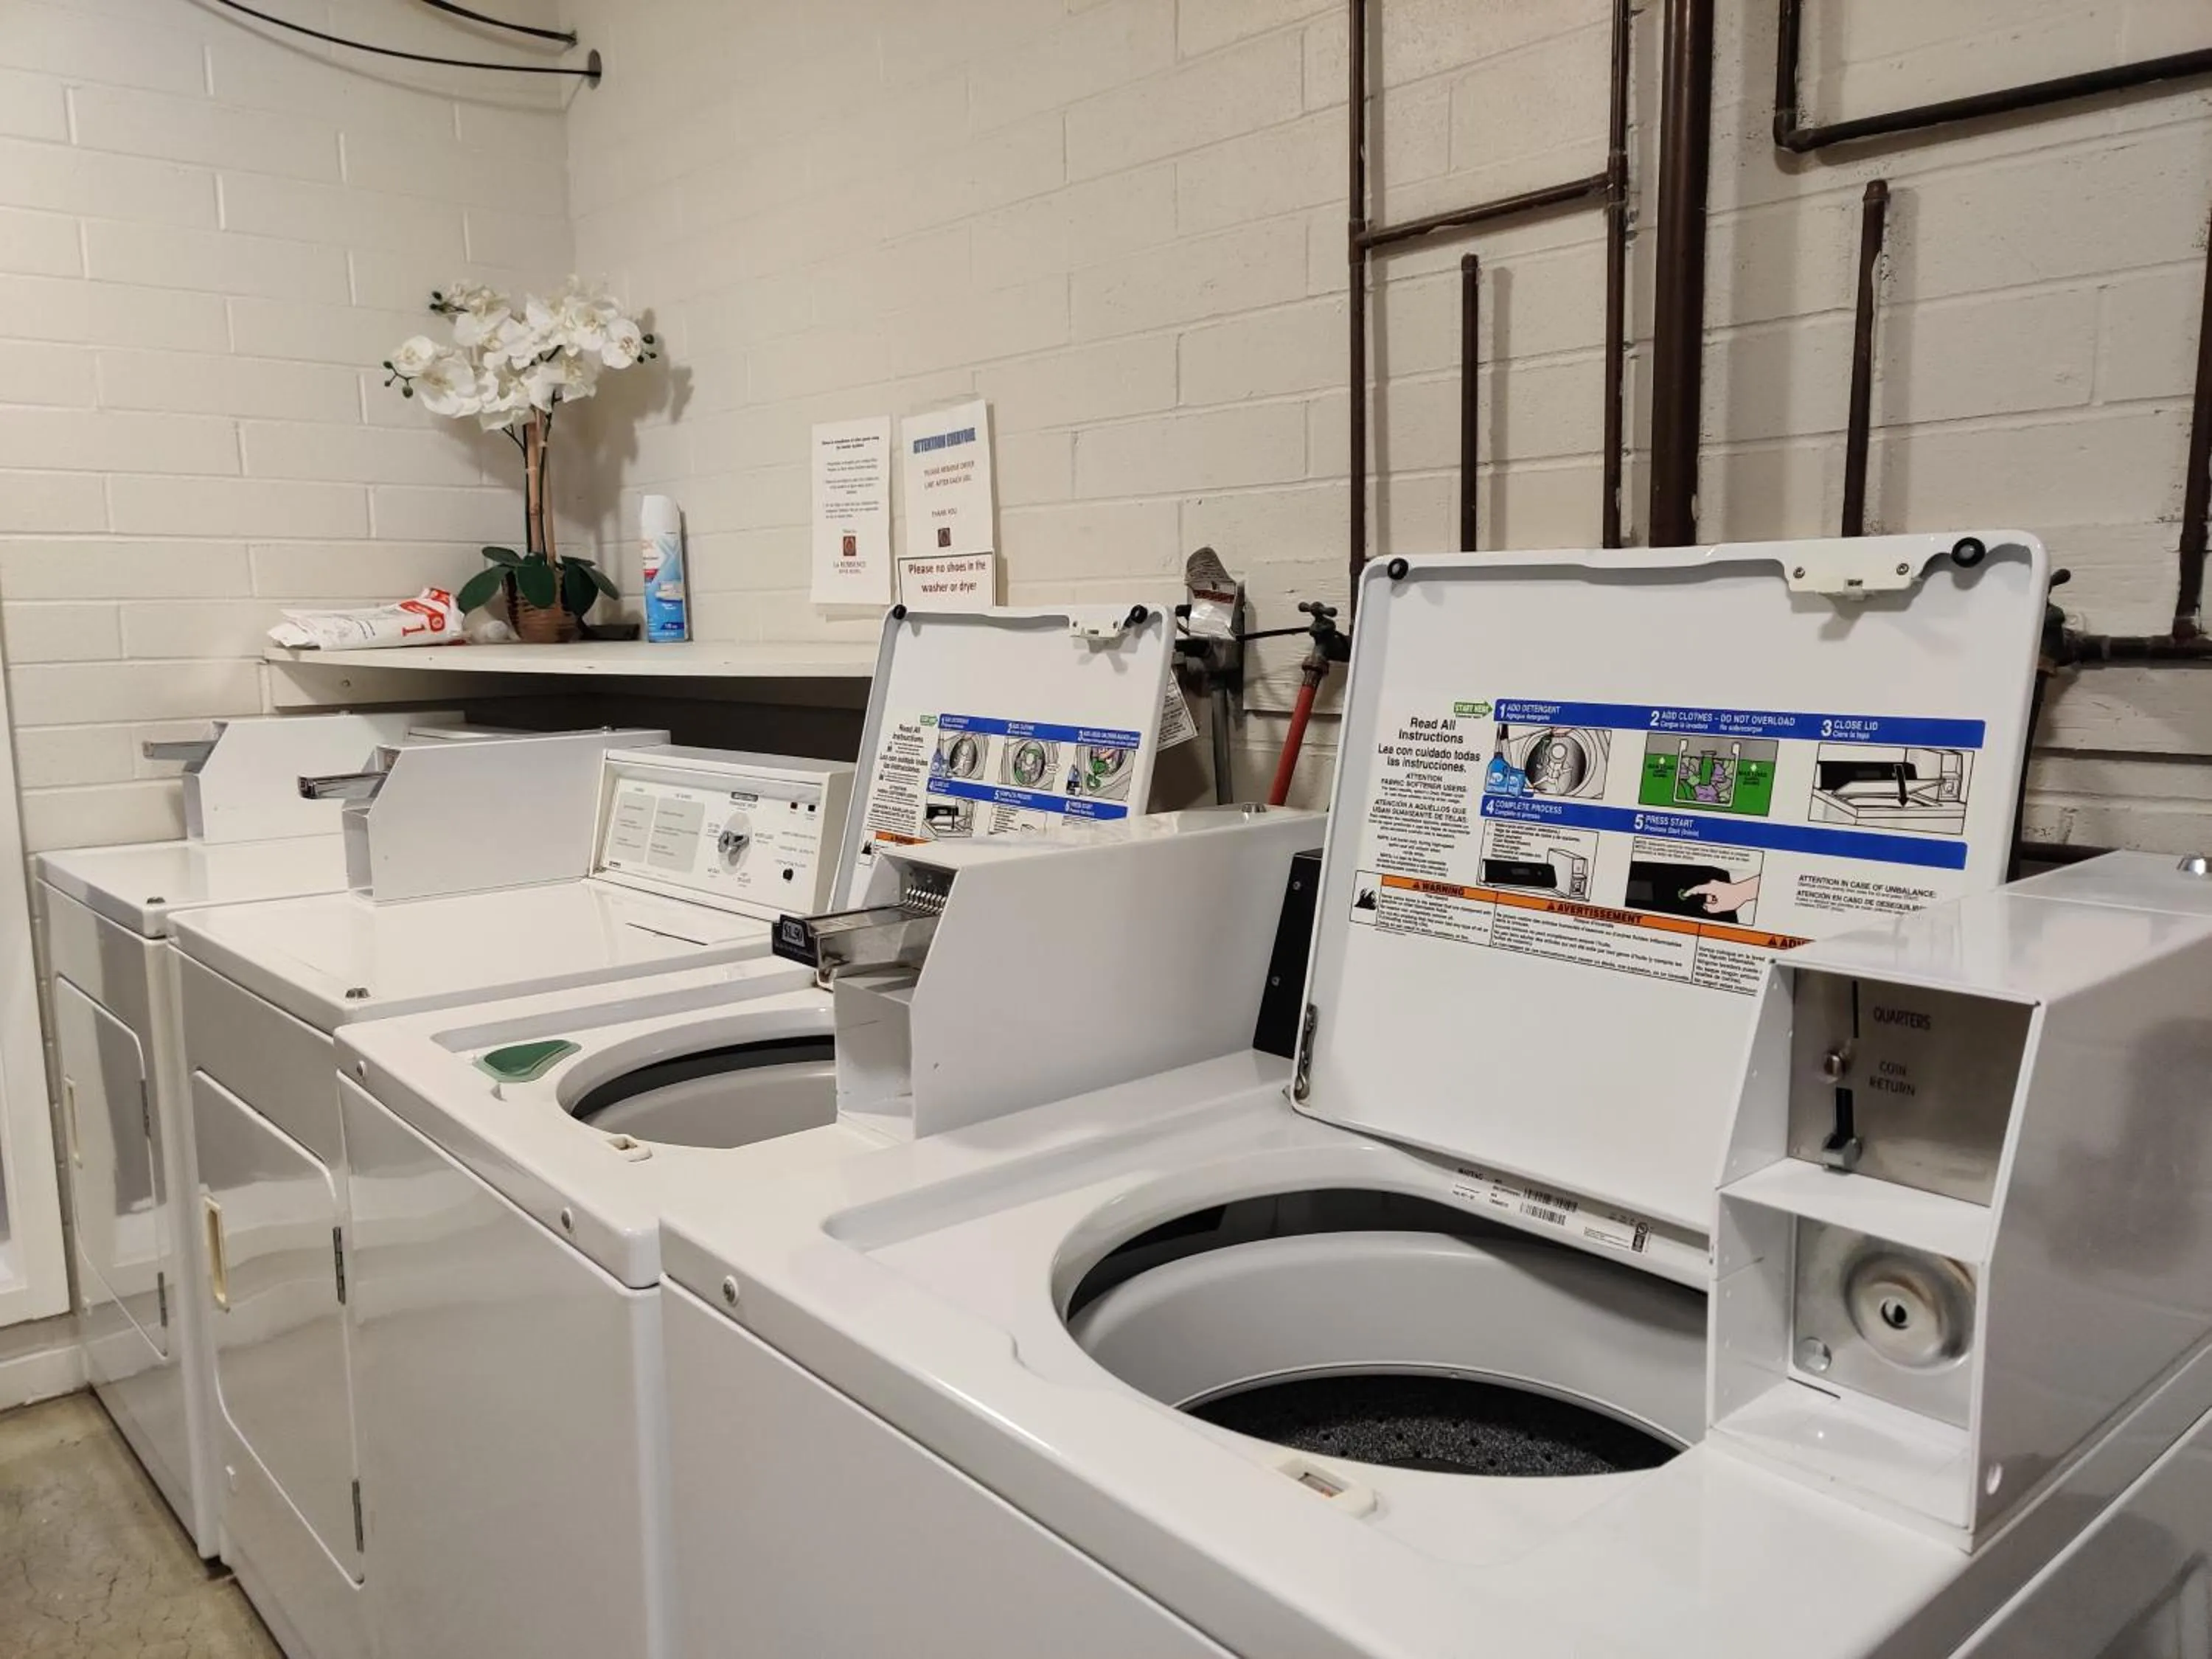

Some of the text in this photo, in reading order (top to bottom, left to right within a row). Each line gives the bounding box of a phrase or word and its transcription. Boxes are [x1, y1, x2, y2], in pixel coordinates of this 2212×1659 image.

[908, 563, 933, 574] Please
[947, 562, 966, 573] shoes
[967, 561, 973, 571] in
[975, 560, 986, 570] the
[921, 581, 977, 594] washer or dryer
[1500, 703, 1561, 719] 1 ADD DETERGENT
[1650, 710, 1659, 726] 2
[1661, 712, 1677, 720] ADD
[1678, 712, 1713, 723] CLOTHES
[1720, 714, 1732, 723] DO
[1734, 714, 1750, 724] NOT
[1751, 715, 1795, 726] OVERLOAD
[1410, 717, 1456, 731] Read All
[1820, 719, 1878, 737] 3 CLOSE LID
[1398, 728, 1464, 744] Instructions
[1377, 742, 1481, 762] Lee con cuidado todas
[1387, 756, 1400, 766] las
[1405, 773, 1443, 782] ATTENTION
[993, 790, 999, 800] 5
[1486, 799, 1562, 815] 4 COMPLETE PROCESS
[1634, 813, 1694, 830] 5 PRESS START
[1422, 881, 1464, 897] WARNING
[1798, 874, 1840, 886] ATTENTION
[1841, 876, 1848, 886] IN
[1850, 879, 1871, 890] CASE
[1873, 883, 1884, 891] OF
[1797, 889, 1831, 900] ATENCIÓN
[1832, 894, 1842, 902] EN
[1843, 895, 1863, 905] CASO
[1864, 898, 1875, 906] DE
[1557, 900, 1643, 925] AVERTISSEMENT
[1874, 1006, 1931, 1031] QUARTERS
[1879, 1060, 1907, 1077] COIN
[1869, 1076, 1916, 1097] RETURN
